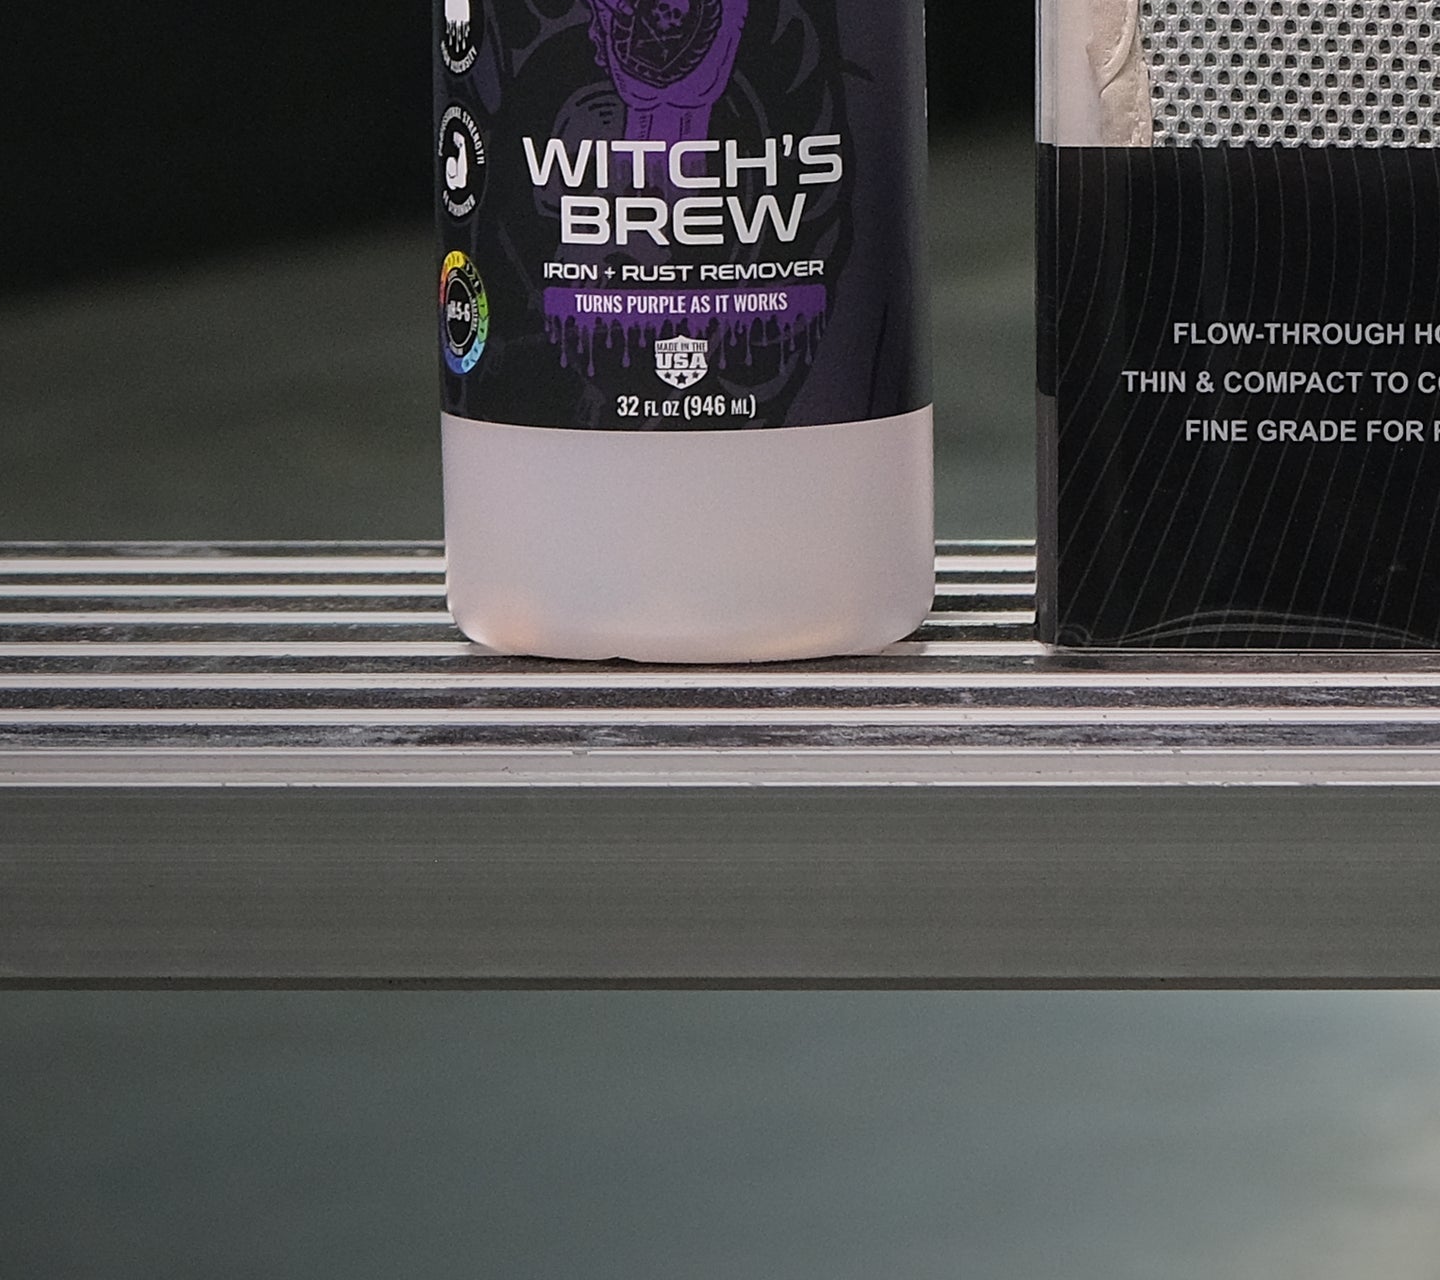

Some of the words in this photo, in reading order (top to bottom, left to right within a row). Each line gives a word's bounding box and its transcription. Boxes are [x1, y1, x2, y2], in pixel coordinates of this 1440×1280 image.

[522, 134, 843, 189] WITCH'S
[560, 193, 807, 246] BREW
[543, 262, 598, 281] IRON
[604, 266, 616, 279] +
[622, 265, 694, 282] RUST
[700, 259, 824, 281] REMOVER
[574, 294, 623, 314] TURNS
[627, 295, 687, 314] PURPLE
[690, 295, 711, 314] AS
[715, 294, 730, 314] IT
[733, 292, 788, 313] WORKS
[1173, 322, 1405, 345] FLOW-THROUGH
[656, 342, 678, 351] MADE
[680, 342, 690, 351] IN
[692, 341, 706, 351] THE
[655, 352, 708, 369] USA
[1121, 370, 1186, 393] THIN
[1195, 370, 1215, 393] &
[1223, 371, 1363, 394] COMPACT
[1370, 371, 1409, 394] TO
[617, 395, 640, 417] 32
[644, 400, 659, 417] FL
[662, 400, 680, 417] OZ
[683, 394, 726, 420] (946
[1185, 419, 1248, 442] FINE
[1256, 419, 1357, 442] GRADE
[1366, 420, 1425, 442] FOR
